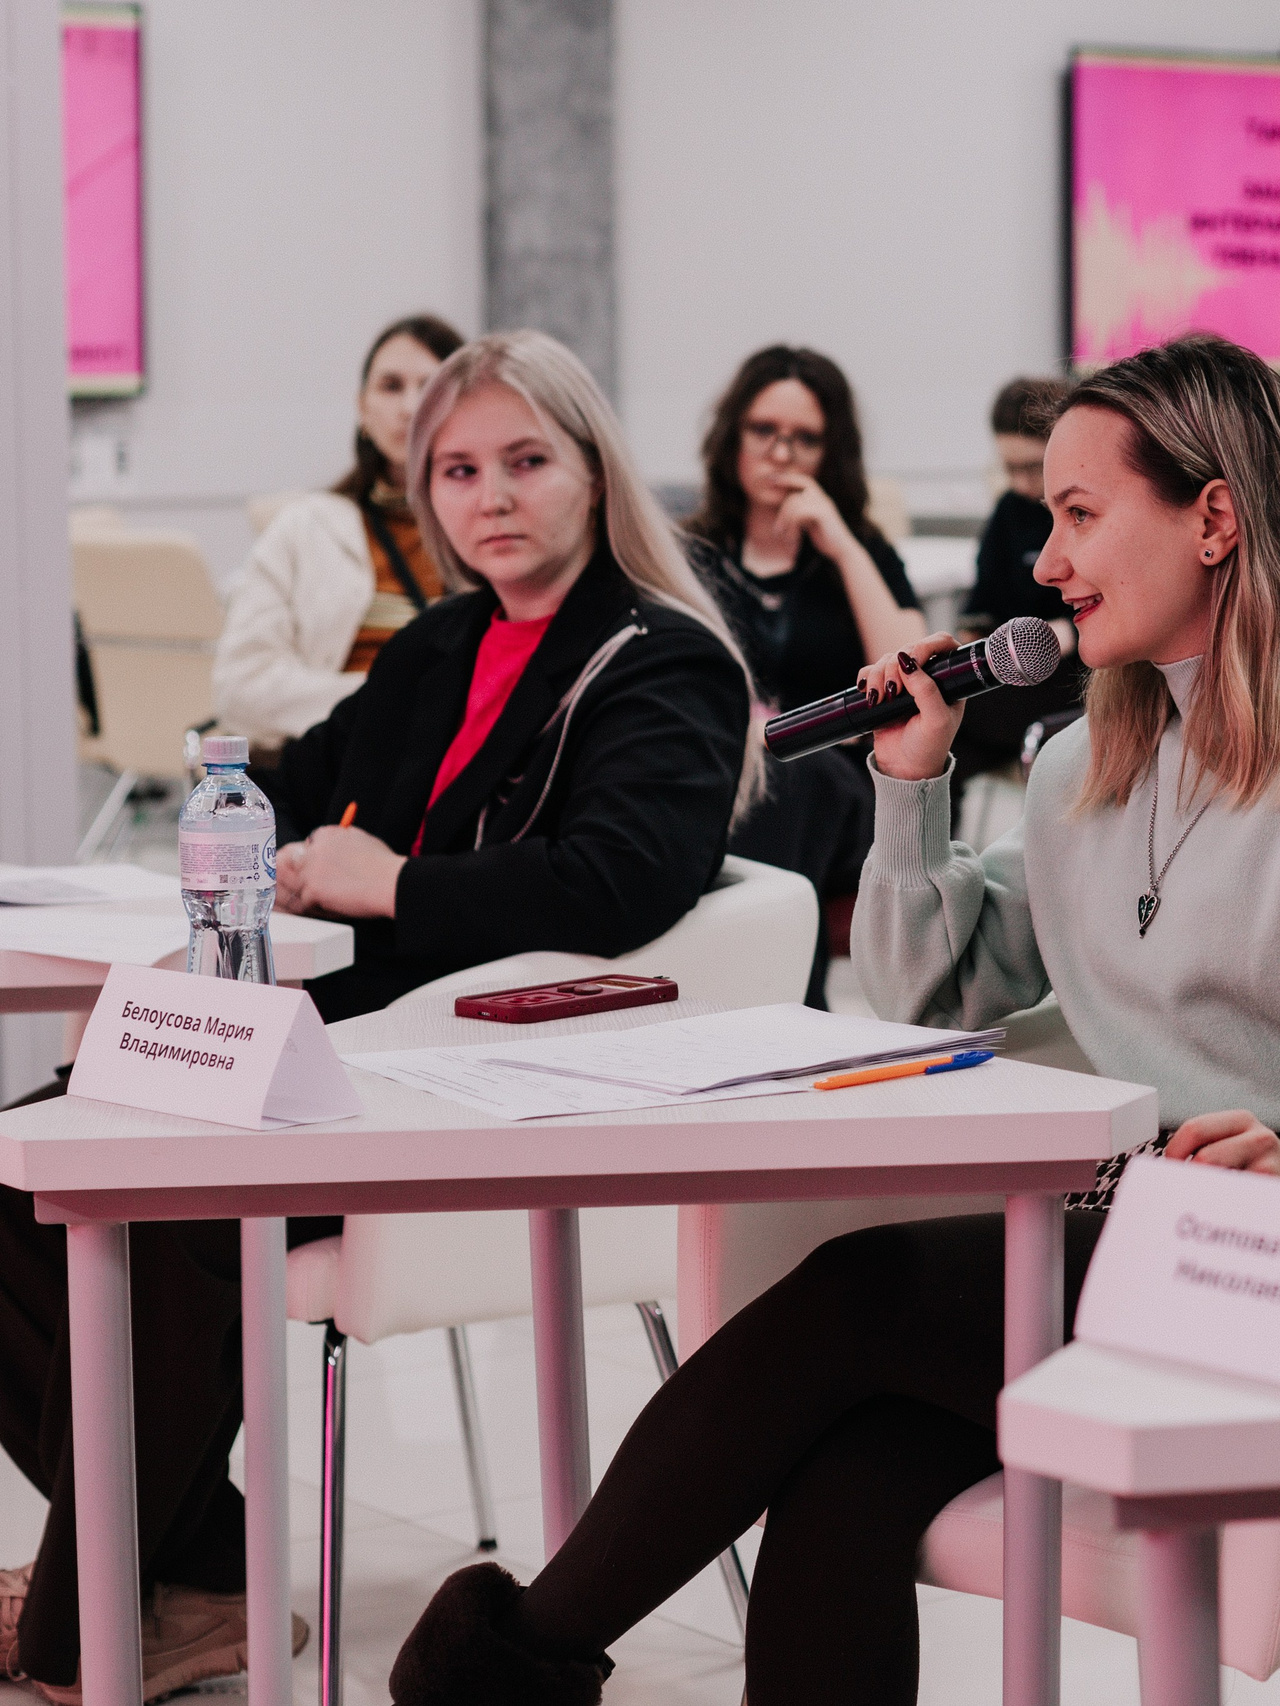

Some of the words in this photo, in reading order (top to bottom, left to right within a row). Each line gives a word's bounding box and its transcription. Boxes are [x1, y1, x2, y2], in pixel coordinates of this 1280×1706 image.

[121, 1000, 201, 1032] Белоусова
[203, 1016, 254, 1042] Мария
[119, 1032, 234, 1070] Владимировна
[1177, 1214, 1280, 1254] Осипова
